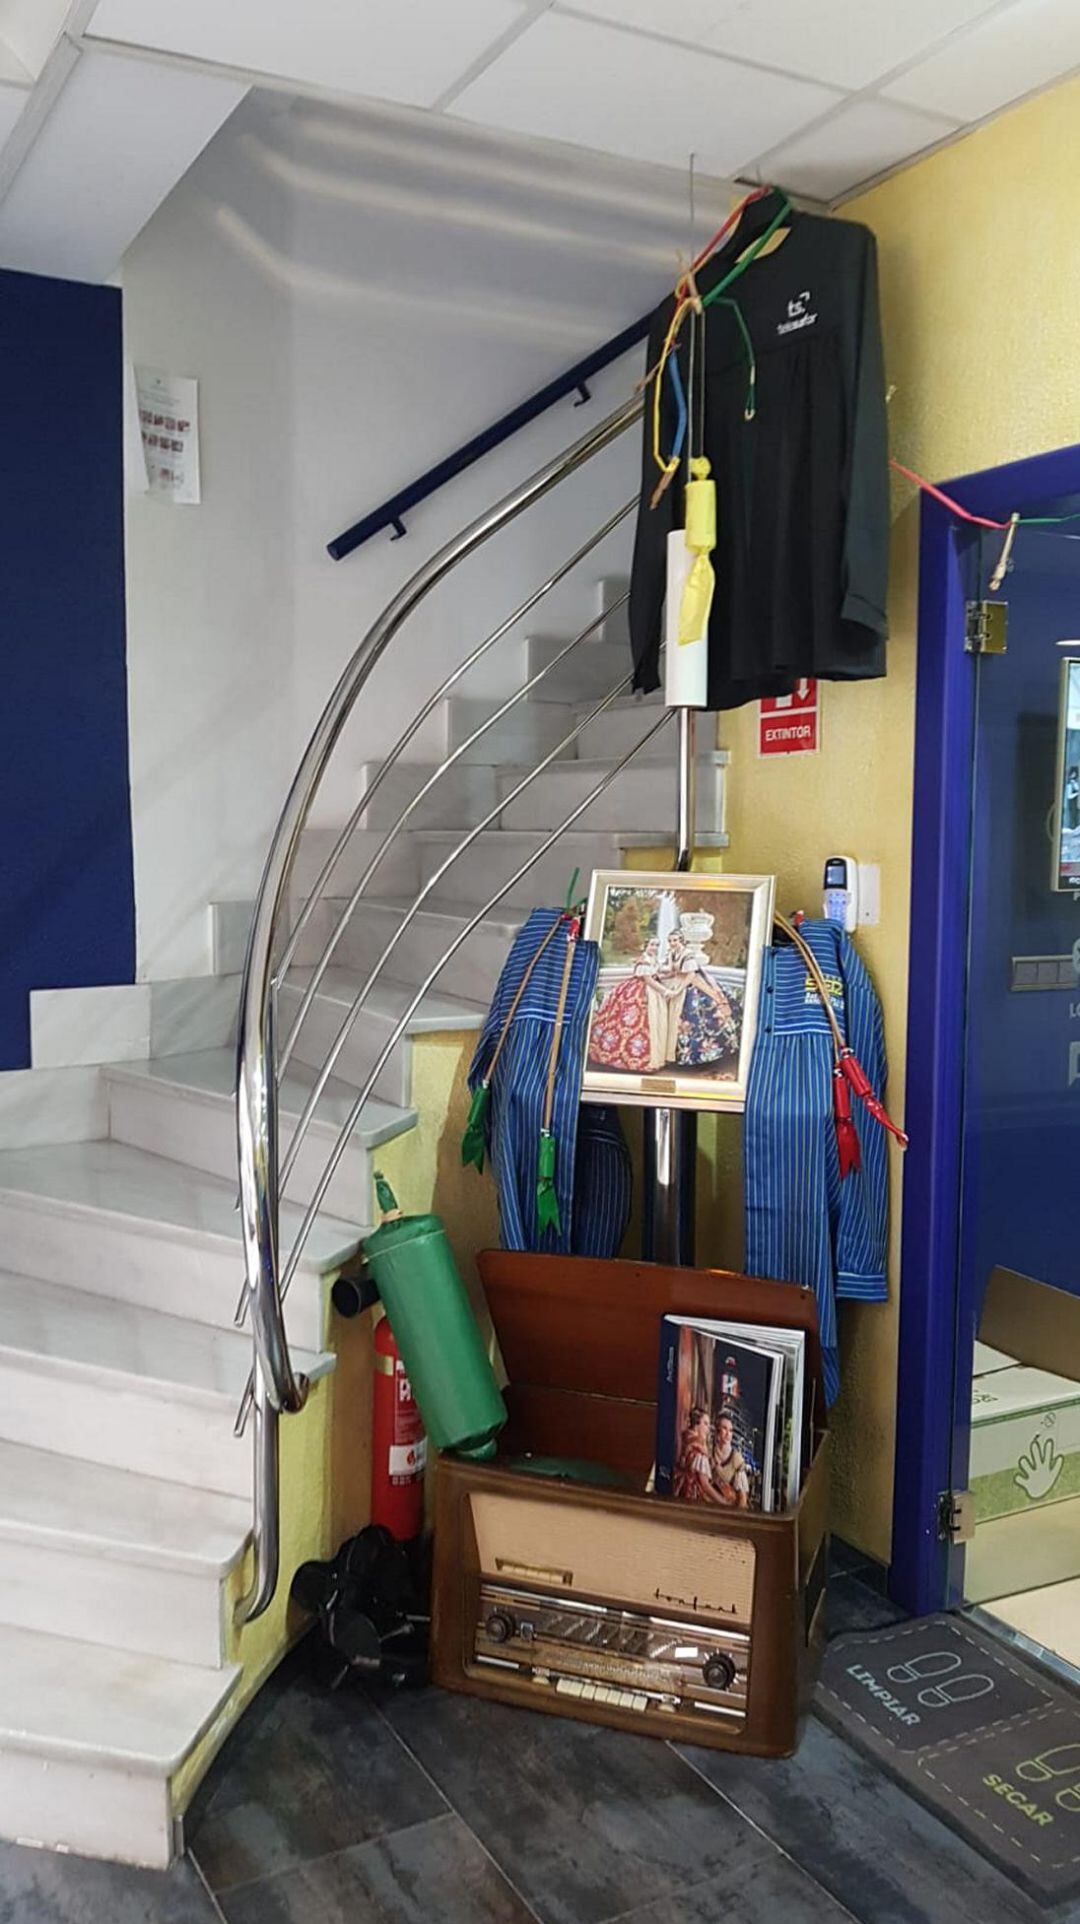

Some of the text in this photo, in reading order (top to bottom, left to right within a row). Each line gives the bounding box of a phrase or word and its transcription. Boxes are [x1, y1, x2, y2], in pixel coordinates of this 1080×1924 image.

[765, 725, 811, 742] EXTINTOR
[846, 1664, 922, 1726] LIMPIAR
[982, 1774, 1055, 1827] SECAR
